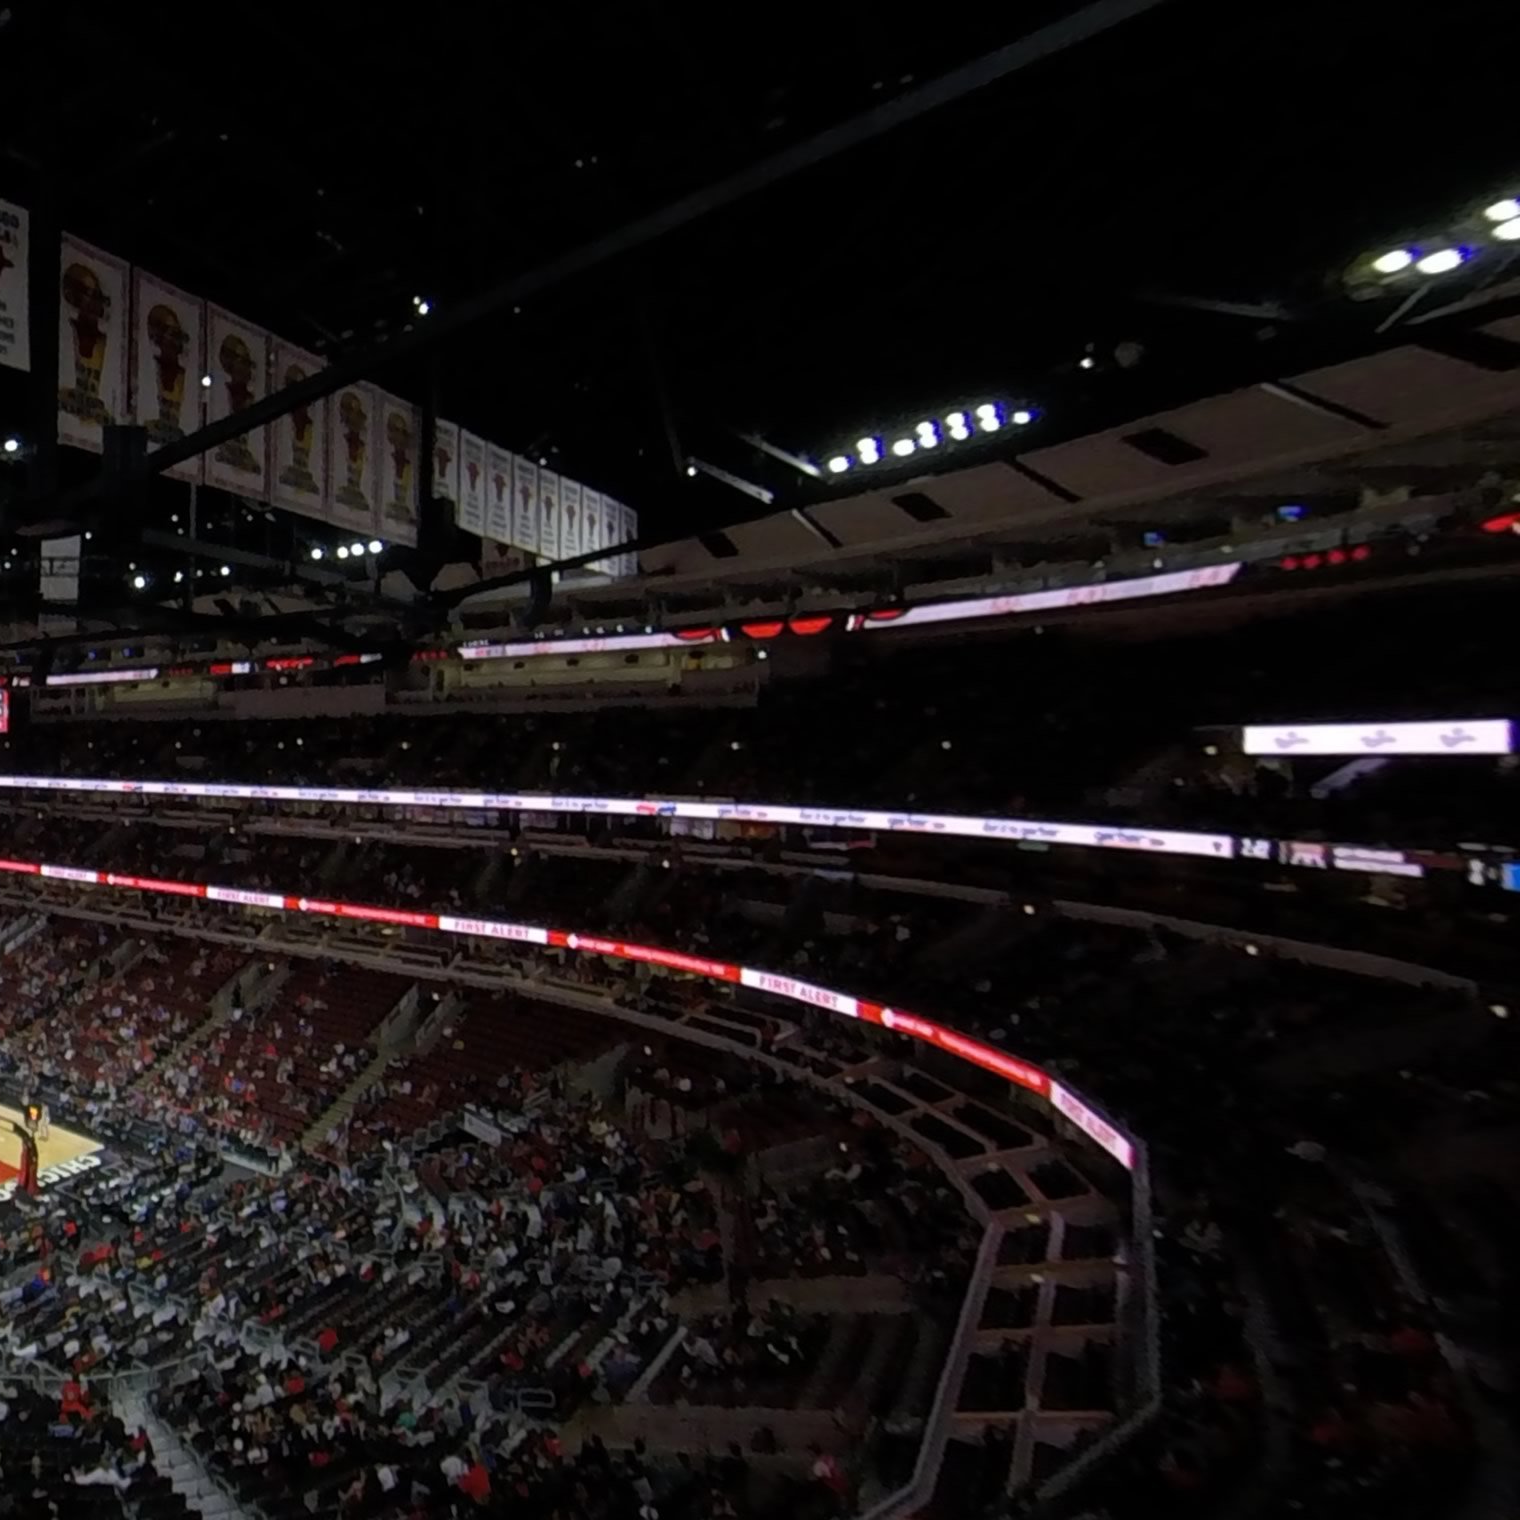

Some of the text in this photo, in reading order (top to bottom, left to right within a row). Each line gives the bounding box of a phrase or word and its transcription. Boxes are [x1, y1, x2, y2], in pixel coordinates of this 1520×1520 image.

[454, 920, 530, 940] FIRST ALERT
[759, 974, 839, 1008] FIRST ALERT
